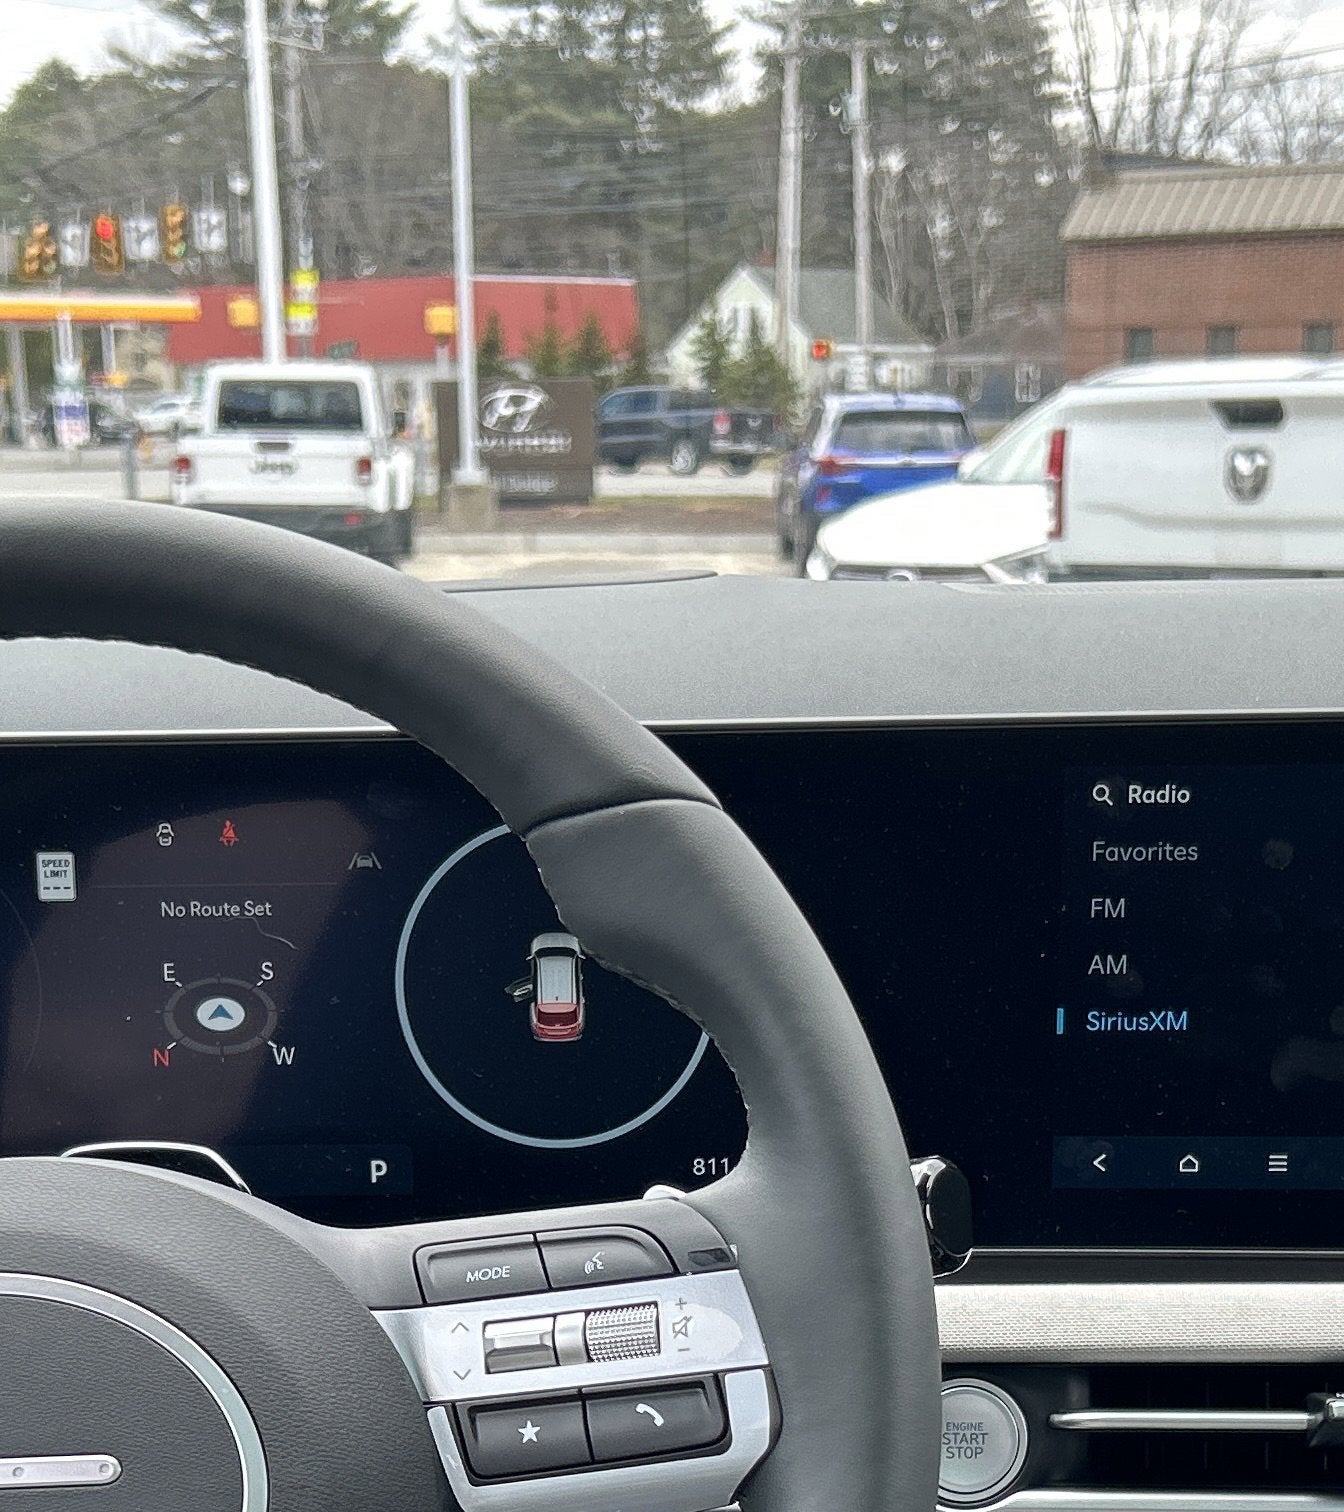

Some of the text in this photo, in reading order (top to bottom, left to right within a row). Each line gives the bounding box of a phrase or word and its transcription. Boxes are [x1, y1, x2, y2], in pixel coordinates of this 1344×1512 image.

[1128, 784, 1191, 804] Radio
[1092, 841, 1199, 862] Favorites
[41, 859, 71, 869] SPEED
[43, 869, 69, 879] LIMIT
[160, 900, 273, 918] No Route Set
[1091, 898, 1126, 918] FM
[163, 962, 176, 982] E
[260, 961, 274, 980] S
[1087, 954, 1127, 975] AM
[1086, 1011, 1188, 1031] SiriusXM
[153, 1049, 170, 1067] N
[272, 1046, 296, 1066] W
[370, 1159, 388, 1184] P
[466, 1264, 511, 1283] MODE
[945, 1421, 984, 1431] ENGINE
[942, 1432, 989, 1445] START
[945, 1446, 984, 1460] STOP
